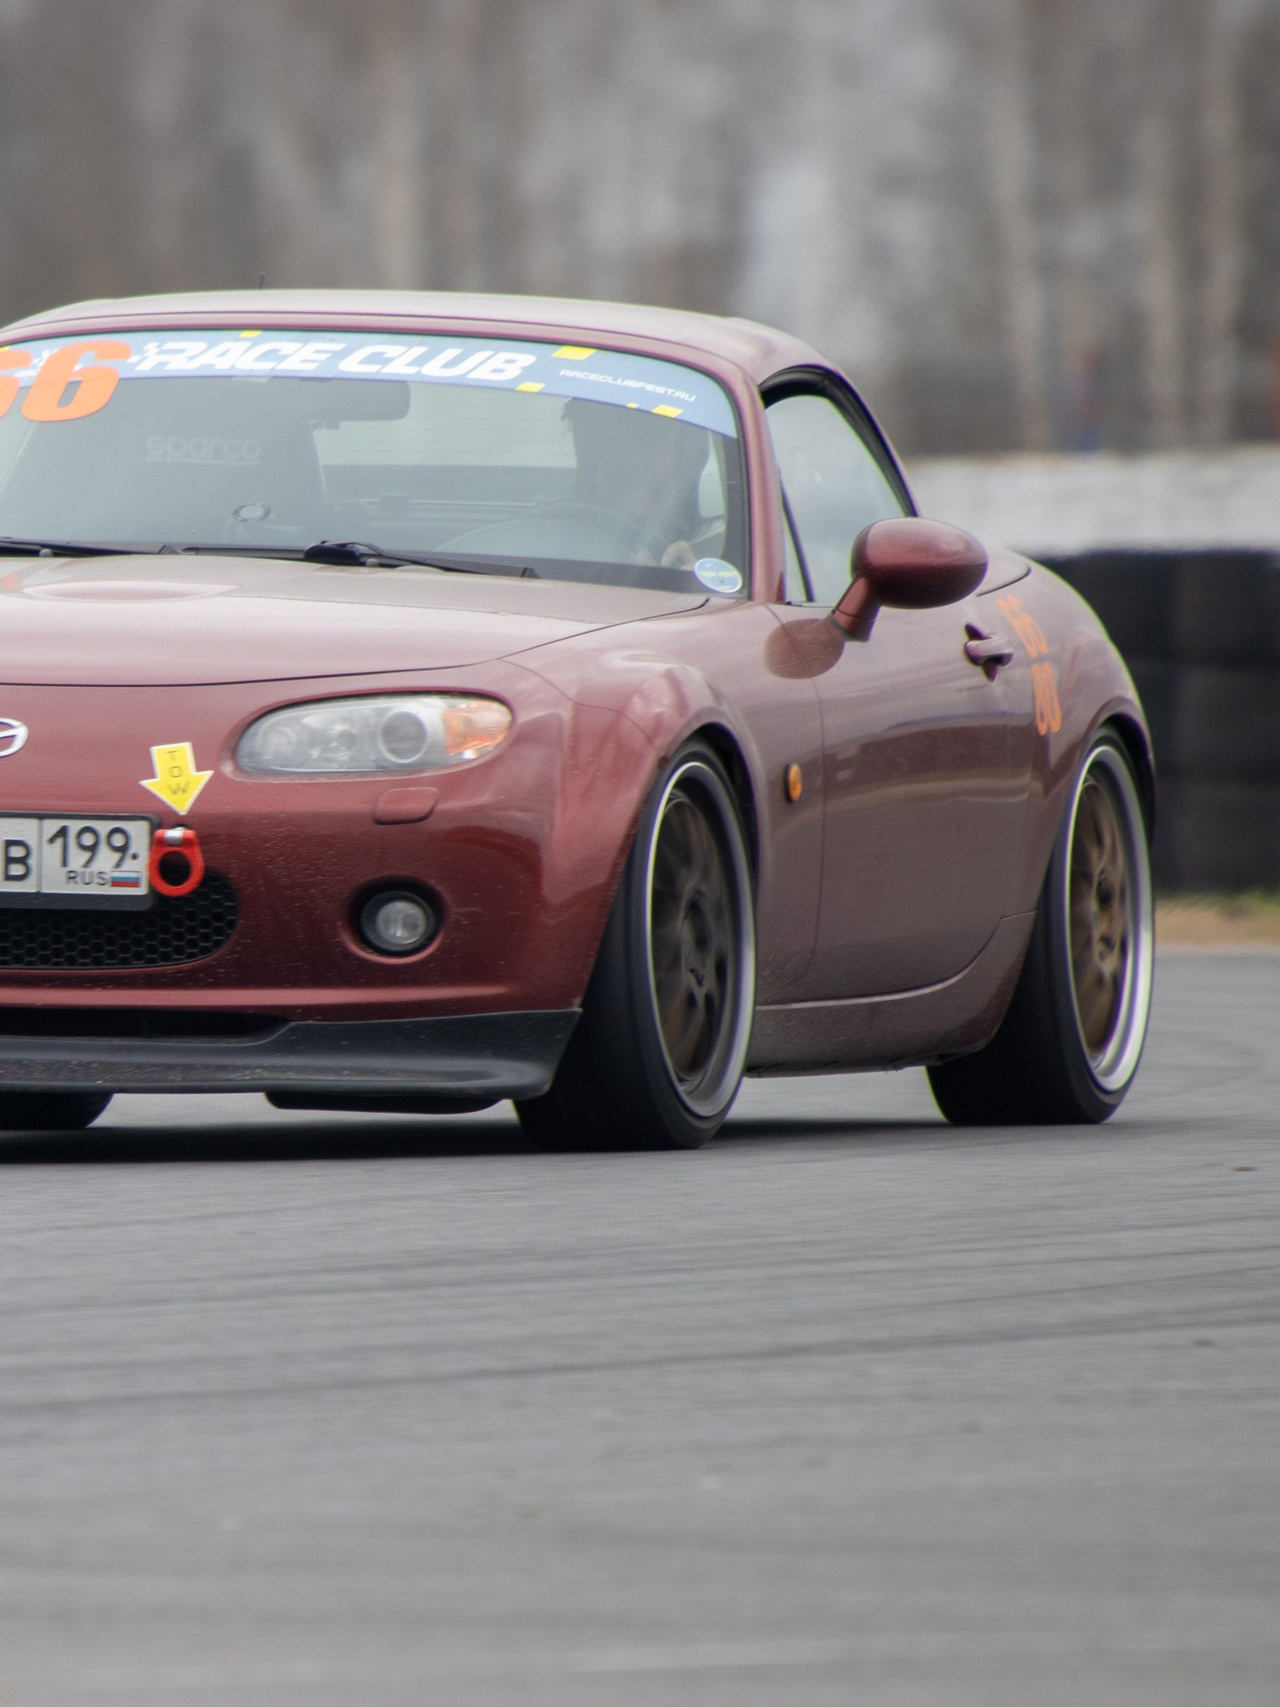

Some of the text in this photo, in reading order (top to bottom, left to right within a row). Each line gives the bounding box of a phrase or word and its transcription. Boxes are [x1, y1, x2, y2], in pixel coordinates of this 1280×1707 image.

[127, 341, 538, 382] RACE CLUB
[559, 368, 697, 402] RACECLUBFEST.RU
[145, 434, 262, 466] sparco
[165, 749, 191, 796] TOW
[47, 825, 131, 869] 199
[65, 870, 109, 886] RUS
